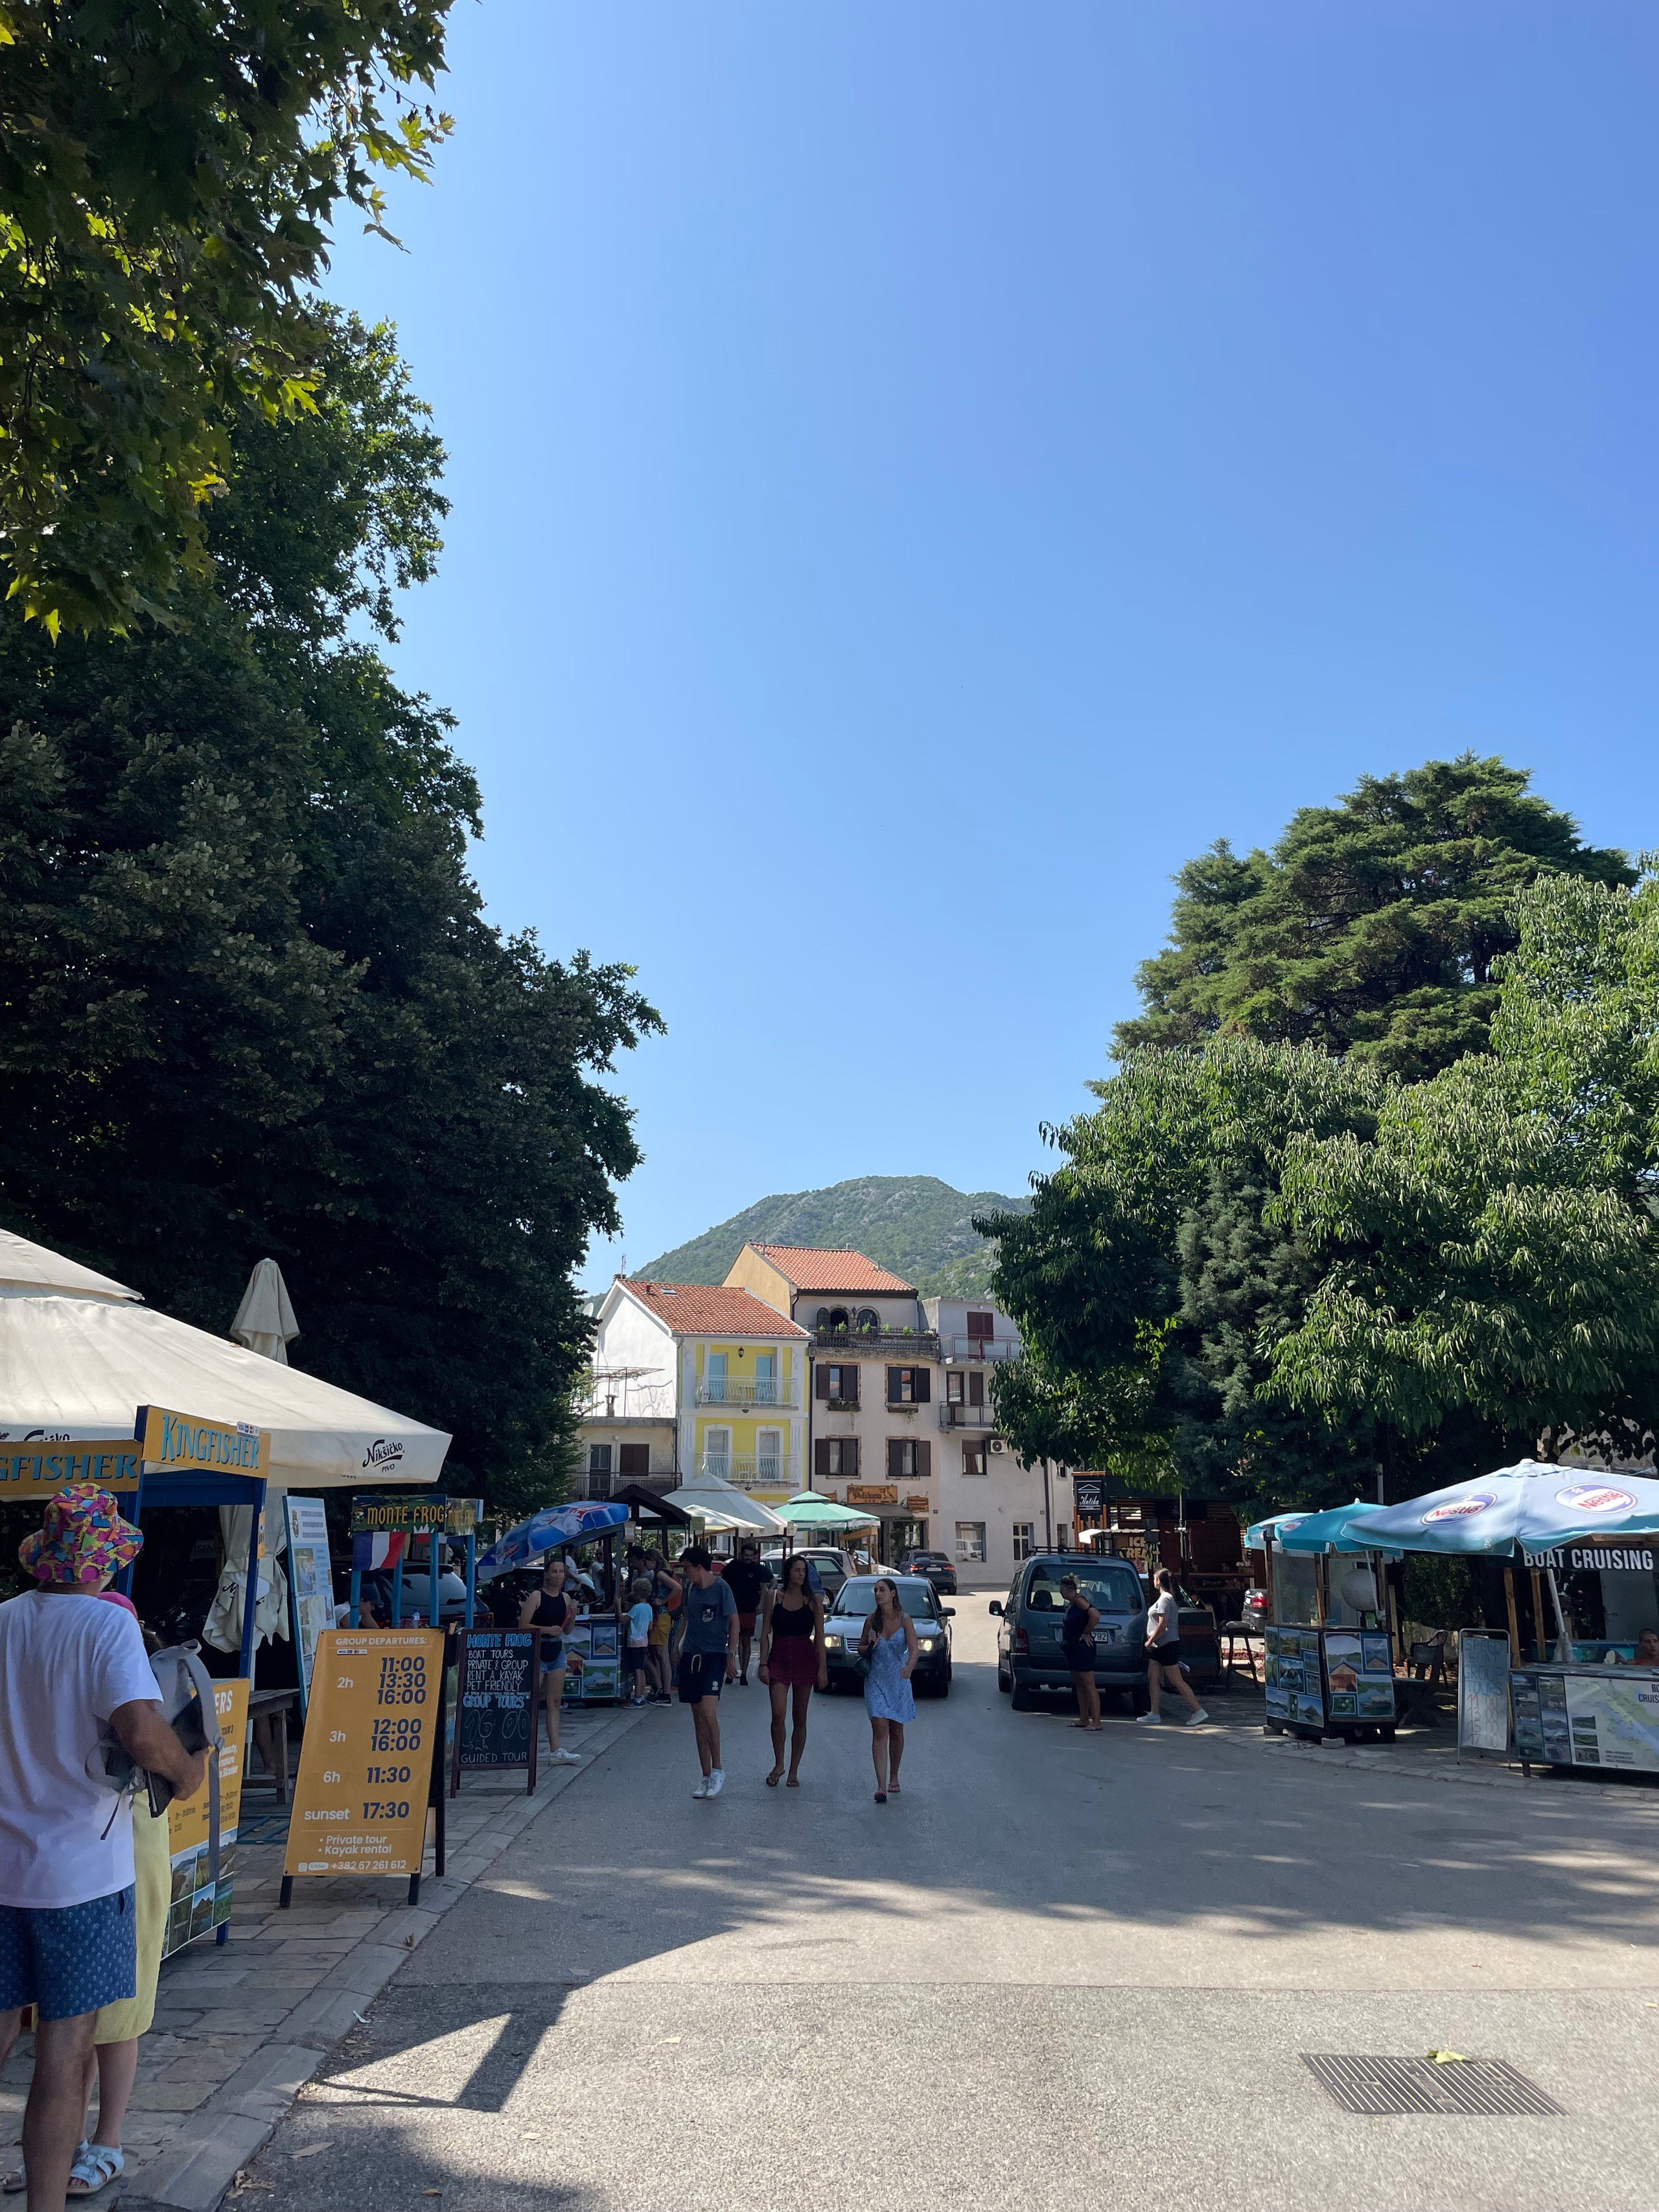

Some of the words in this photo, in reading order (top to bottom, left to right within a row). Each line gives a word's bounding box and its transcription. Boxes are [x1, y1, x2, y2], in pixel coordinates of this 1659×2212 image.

[161, 1414, 261, 1469] KINGFISHER
[381, 1463, 395, 1473] PIVO
[367, 1506, 408, 1525] MONTE
[413, 1505, 445, 1523] FROG
[1524, 1548, 1565, 1568] BOAT
[1572, 1548, 1653, 1570] CRUISING
[368, 1636, 428, 1646] DEPARTURES:
[467, 1633, 502, 1648] MONTE
[505, 1633, 532, 1647] FROG
[1465, 1639, 1502, 1655] SPEED
[469, 1650, 487, 1659] BOAT
[491, 1649, 513, 1659] TOURS
[1468, 1653, 1497, 1664] BOAT
[382, 1657, 425, 1672] 11:00
[468, 1660, 493, 1670] PRIVATE
[501, 1660, 529, 1670] GROUP
[336, 1677, 354, 1688] 2h
[379, 1672, 426, 1688] 13:30
[467, 1670, 487, 1681] RENT
[489, 1670, 495, 1680] A
[500, 1670, 524, 1681] KAYAK
[1464, 1665, 1503, 1682] GROUP
[467, 1681, 482, 1691] PET
[485, 1680, 522, 1692] FRIENDLY
[1465, 1680, 1502, 1695] TOURS
[377, 1689, 426, 1705] 16:00
[463, 1695, 491, 1708] GROUP
[495, 1695, 525, 1708] TOURS
[373, 1718, 422, 1734] 12:00
[329, 1730, 346, 1742] 3h
[371, 1734, 421, 1751] 16:00
[461, 1752, 498, 1763] GUIDED
[502, 1752, 528, 1762] TOUR
[323, 1771, 341, 1783] 6h
[367, 1766, 411, 1784] 11:30
[304, 1808, 350, 1821] sunset
[362, 1801, 410, 1819] 17:30
[326, 1835, 363, 1845] Private
[365, 1835, 388, 1845] tour
[325, 1845, 358, 1857] Kayak
[360, 1845, 392, 1854] rental
[331, 1861, 356, 1870] +382
[358, 1861, 371, 1869] 67
[372, 1861, 389, 1869] 261
[390, 1860, 406, 1869] 612
